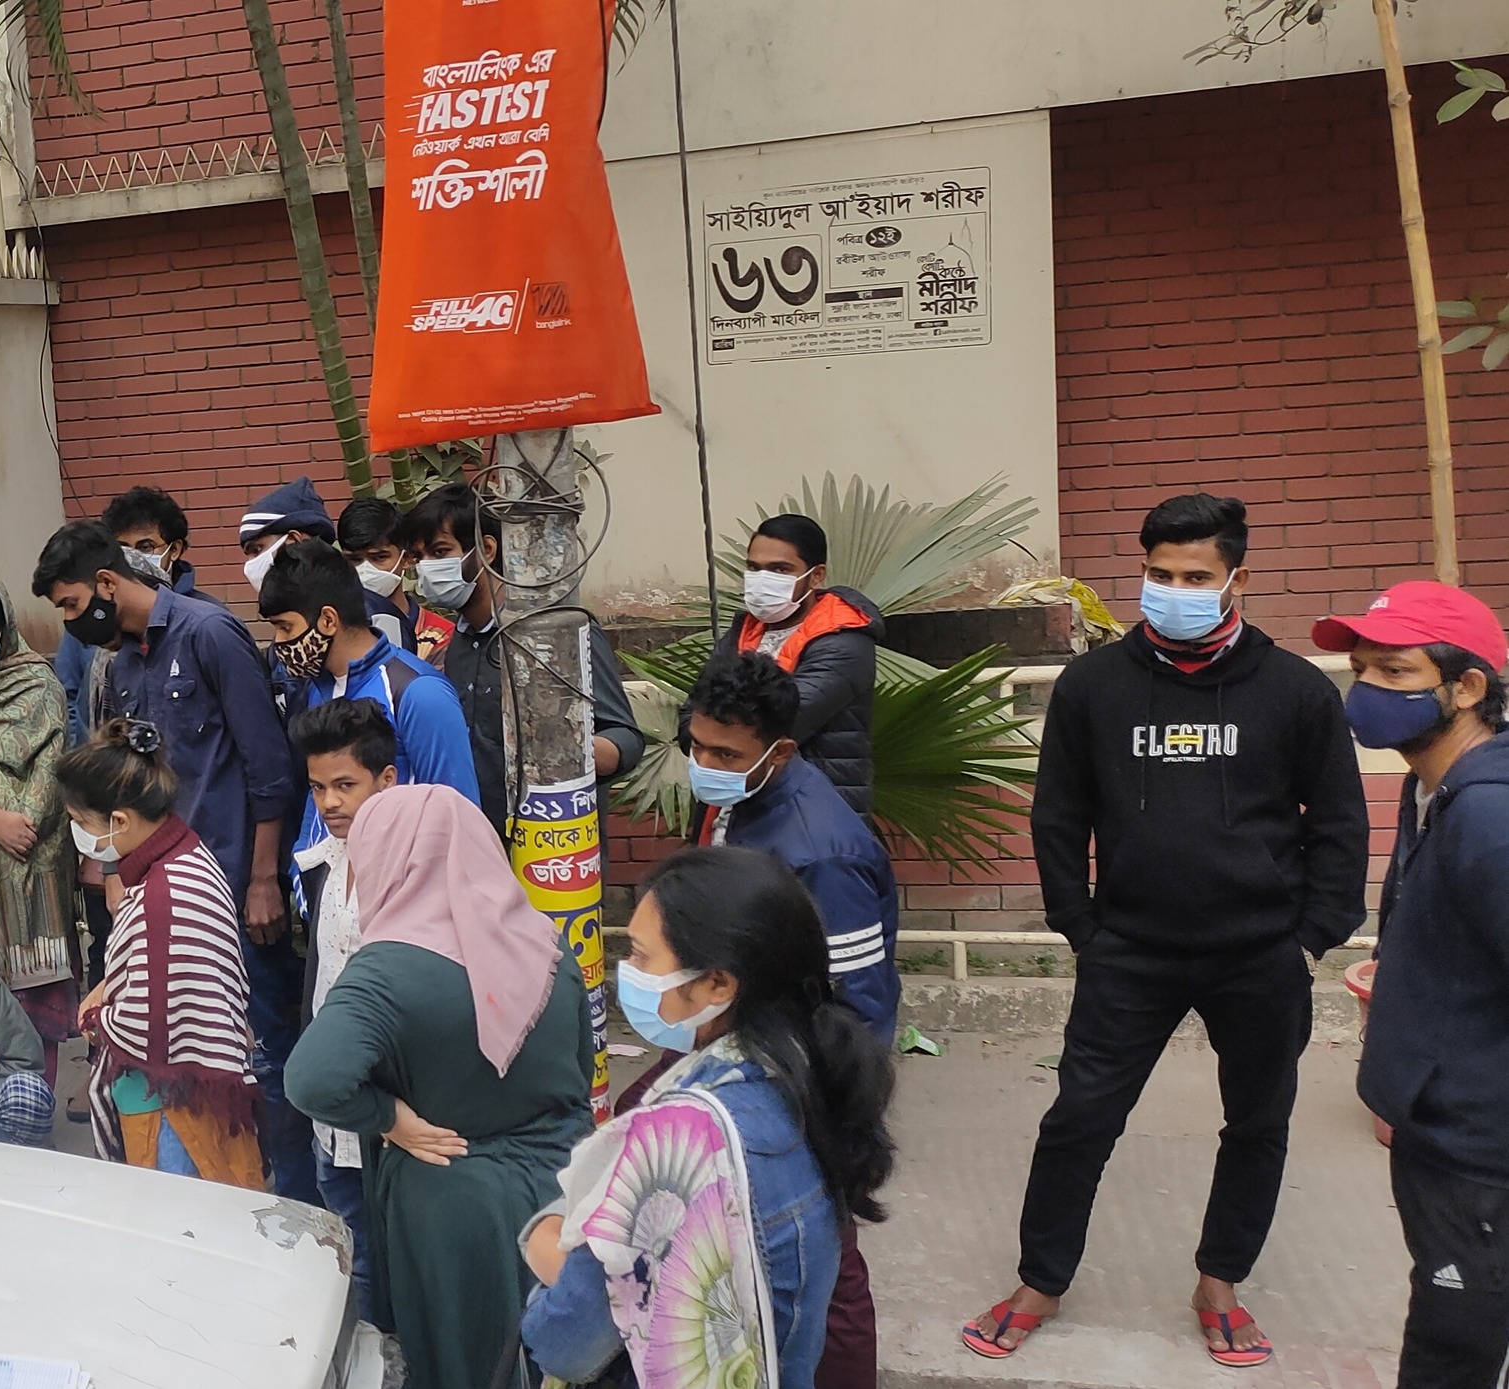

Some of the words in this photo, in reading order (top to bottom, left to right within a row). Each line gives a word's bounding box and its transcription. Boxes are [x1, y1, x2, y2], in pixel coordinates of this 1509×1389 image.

[423, 50, 522, 88] বাংলালিংক
[525, 49, 557, 73] এর
[417, 80, 550, 133] FASTEST
[464, 134, 497, 150] এখন
[412, 150, 548, 210] শক্তিশালী
[920, 182, 987, 209] শরীফ
[712, 246, 818, 313] ৬৩
[916, 271, 978, 297] মীলাদ
[429, 299, 472, 316] FULL
[467, 295, 513, 327] 4G
[920, 291, 978, 315] শরীফ
[412, 314, 470, 331] SPEED
[710, 312, 767, 331] দিনব্যাপী
[771, 309, 821, 326] মাহফিল
[1132, 723, 1238, 757] ELECTRO
[518, 800, 563, 820] ০২১
[534, 826, 581, 850] থেকে
[530, 856, 574, 885] ভর্তি
